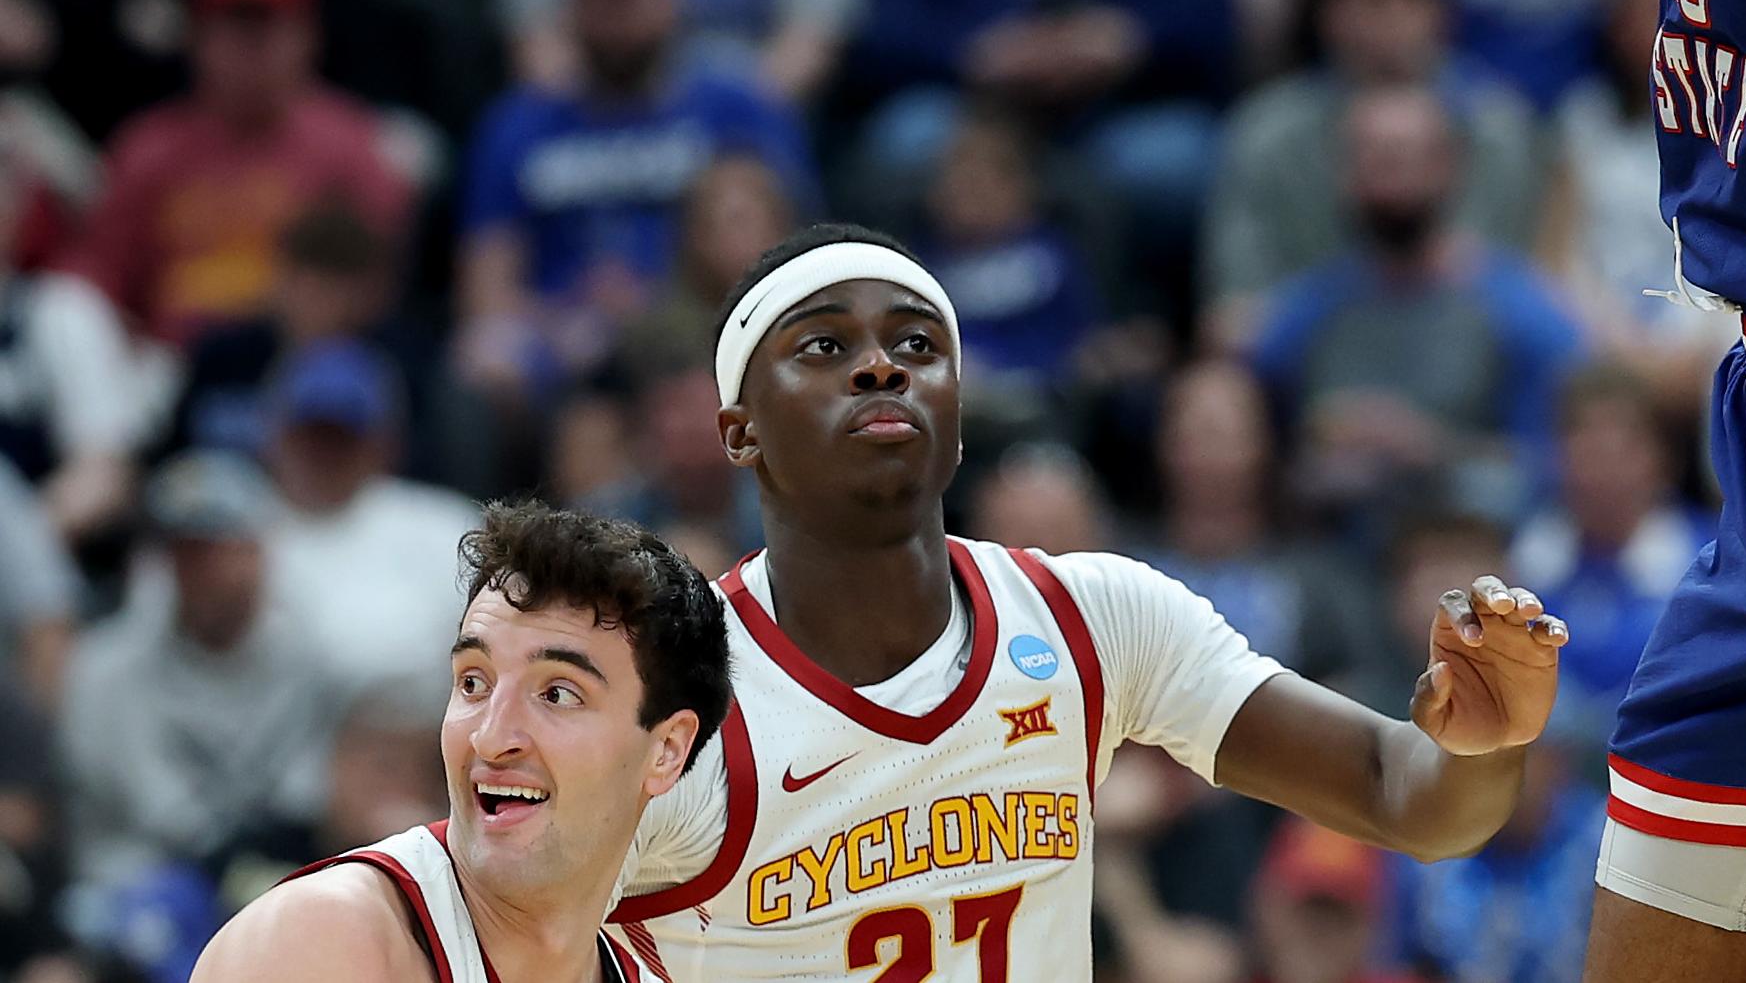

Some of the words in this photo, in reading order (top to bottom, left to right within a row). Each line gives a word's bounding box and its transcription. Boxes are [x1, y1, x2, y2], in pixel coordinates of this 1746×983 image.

[1019, 650, 1057, 670] NCAA
[747, 792, 1079, 925] CYCLONES
[843, 879, 1026, 983] 27
